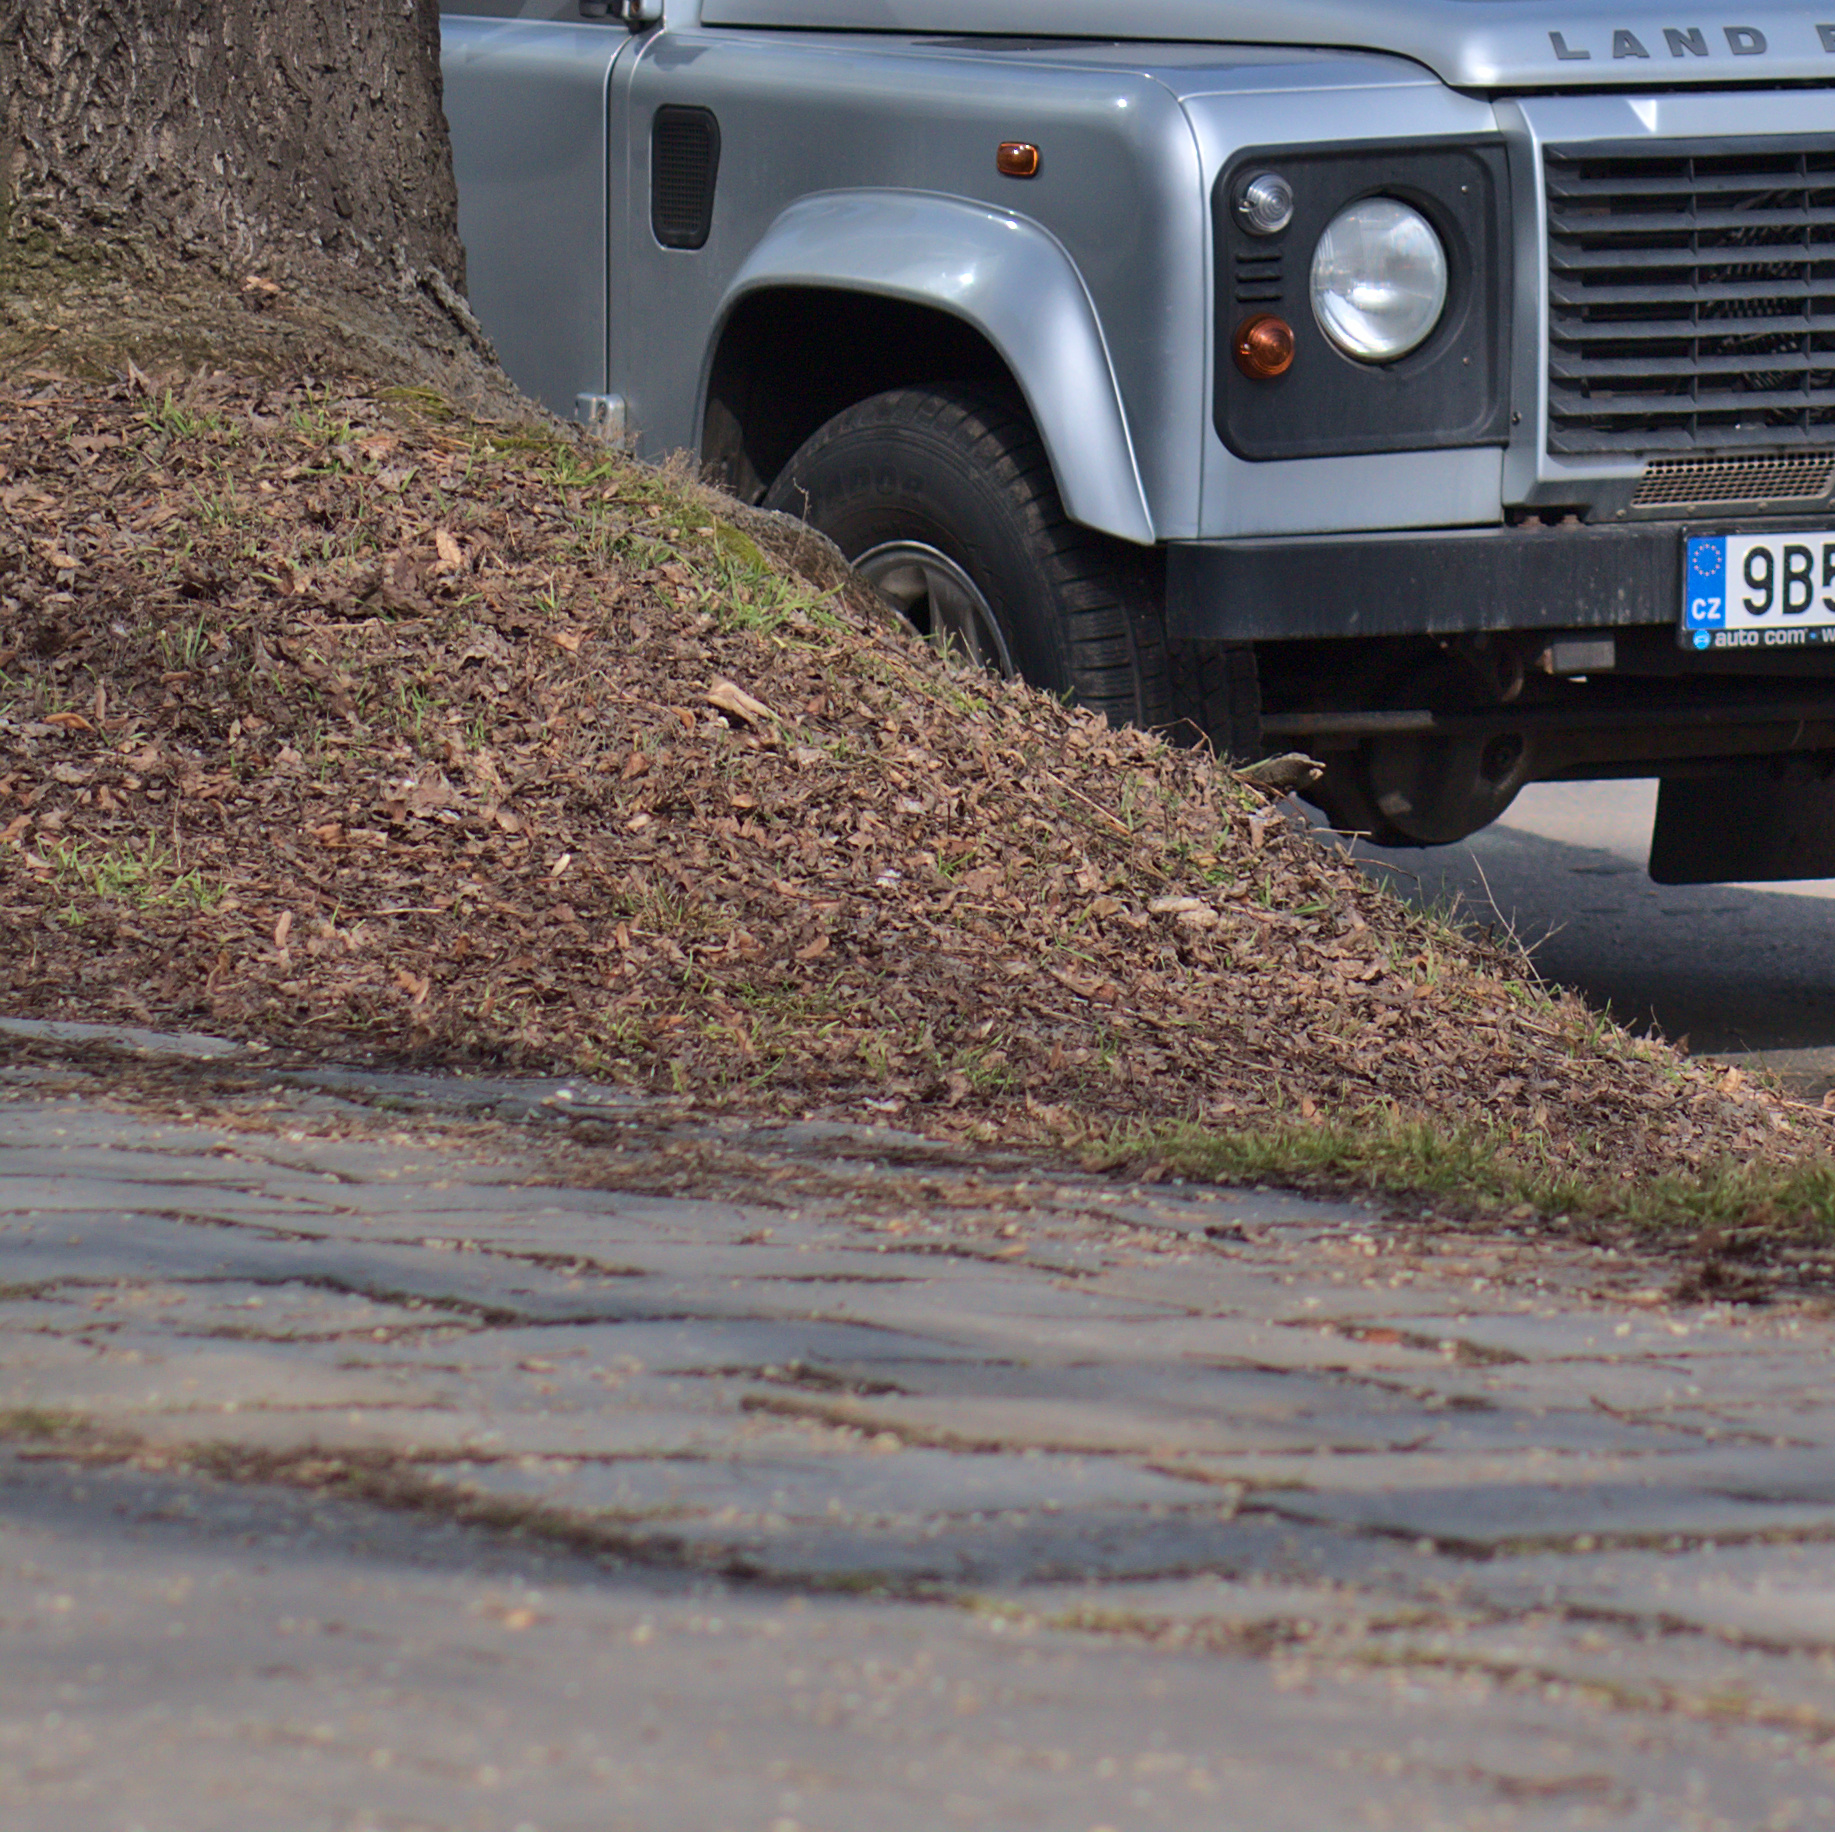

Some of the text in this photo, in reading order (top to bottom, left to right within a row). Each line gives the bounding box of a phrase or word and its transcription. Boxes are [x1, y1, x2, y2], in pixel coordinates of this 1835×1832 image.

[1548, 26, 1768, 60] LAND
[1691, 597, 1722, 621] CZ
[1714, 629, 1759, 647] auto
